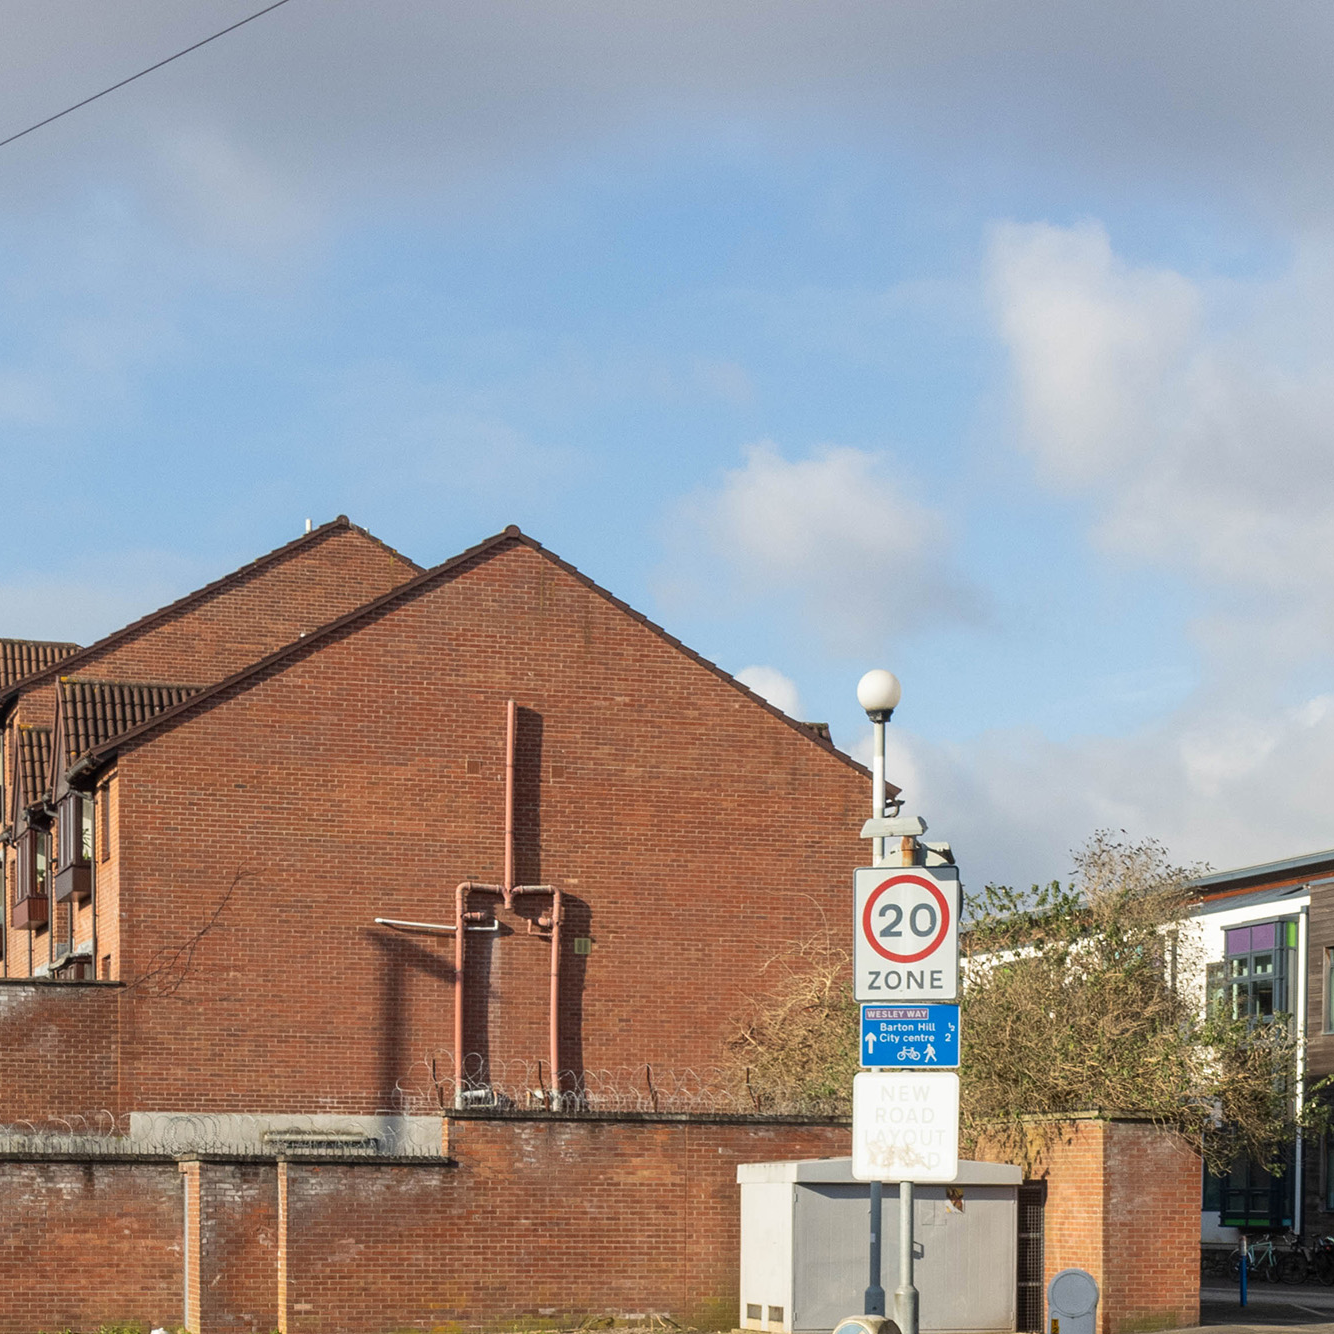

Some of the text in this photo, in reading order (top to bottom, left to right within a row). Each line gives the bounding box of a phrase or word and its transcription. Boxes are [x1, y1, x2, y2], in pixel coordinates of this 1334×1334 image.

[878, 903, 937, 937] 20
[868, 970, 943, 990] ZONE
[867, 1010, 927, 1018] WESLEY WAY
[880, 1022, 914, 1032] Barton
[917, 1022, 936, 1032] Hill
[879, 1033, 952, 1044] City centre 2
[880, 1085, 931, 1102] NEW
[875, 1106, 935, 1124] ROAD
[864, 1129, 946, 1146] LAYOUT
